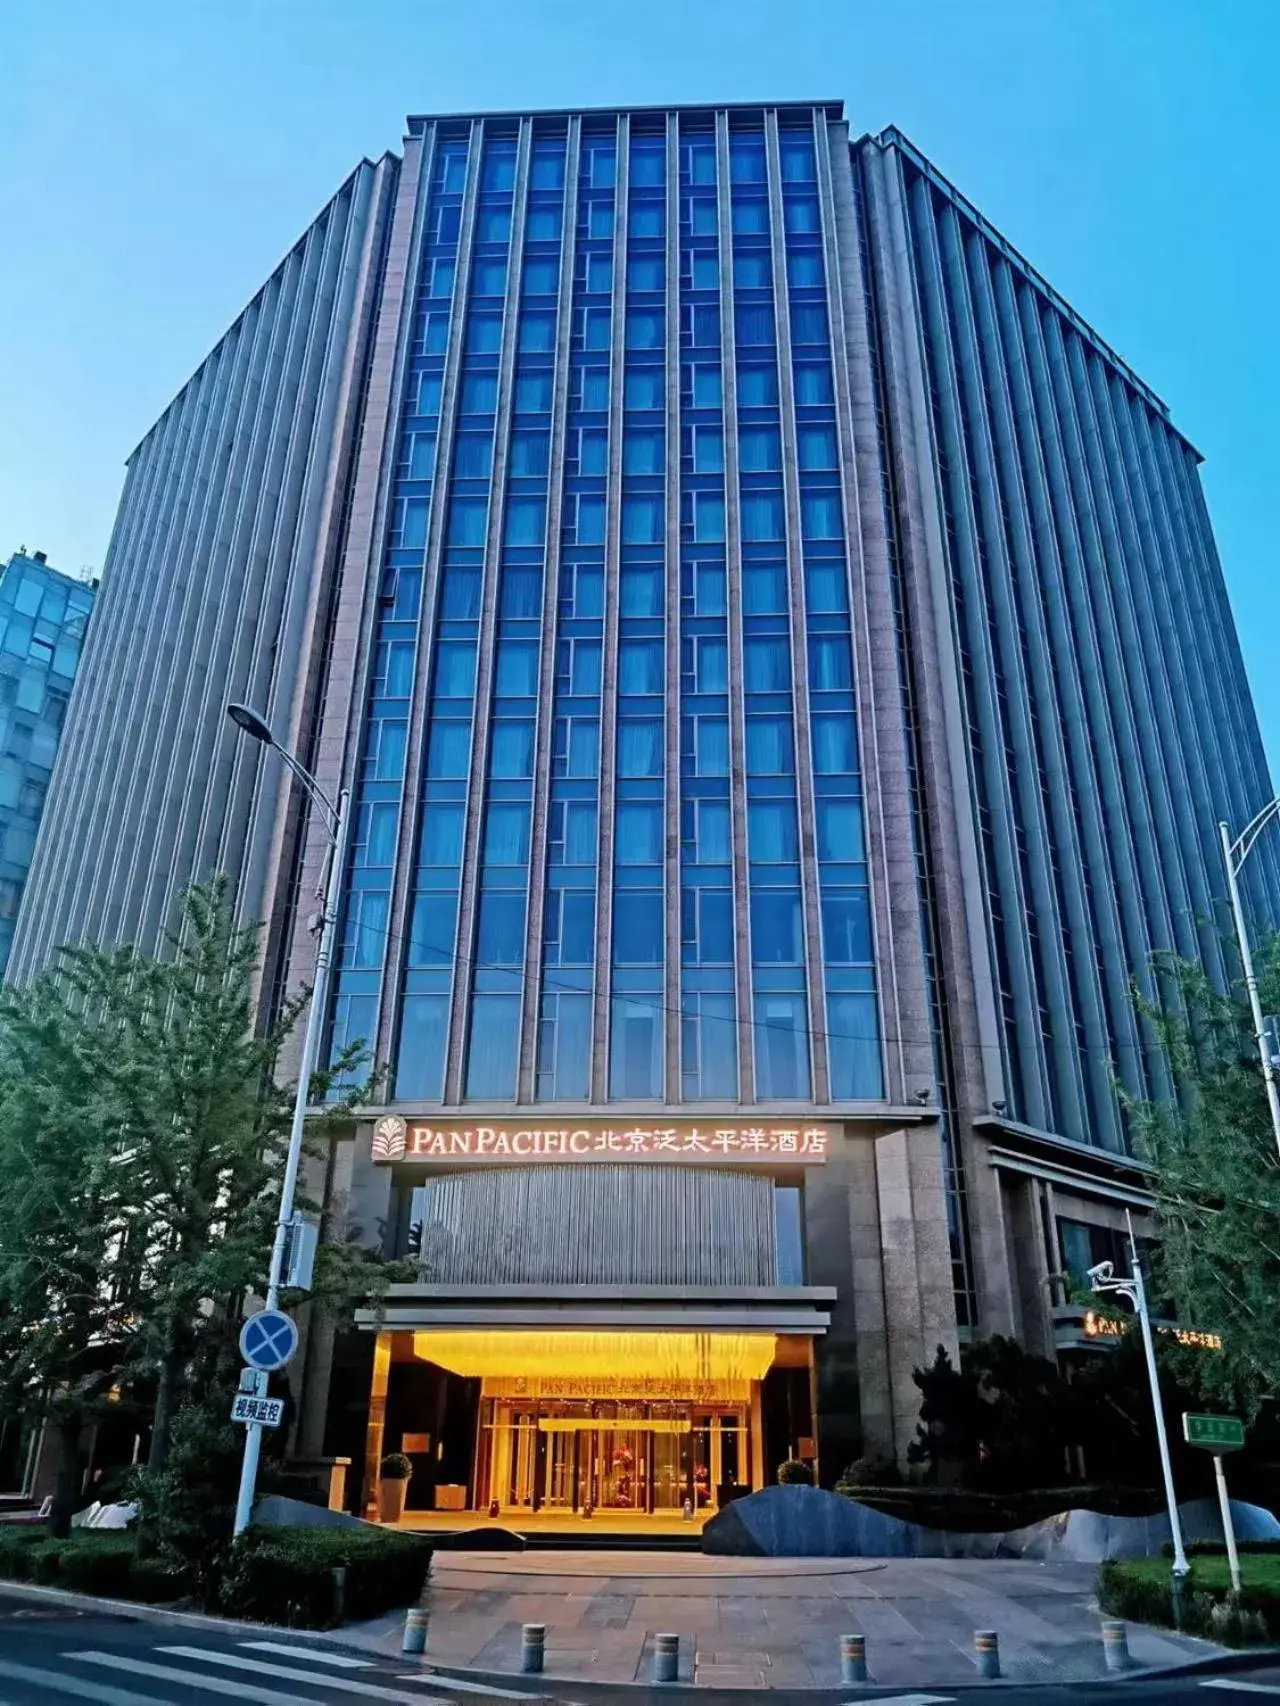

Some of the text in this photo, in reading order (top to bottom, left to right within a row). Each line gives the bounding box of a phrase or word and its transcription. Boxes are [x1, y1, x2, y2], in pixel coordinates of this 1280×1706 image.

[412, 1127, 828, 1154] PAN PACIFIC 北京泛太平洋酒店
[235, 1399, 280, 1421] 视频监控
